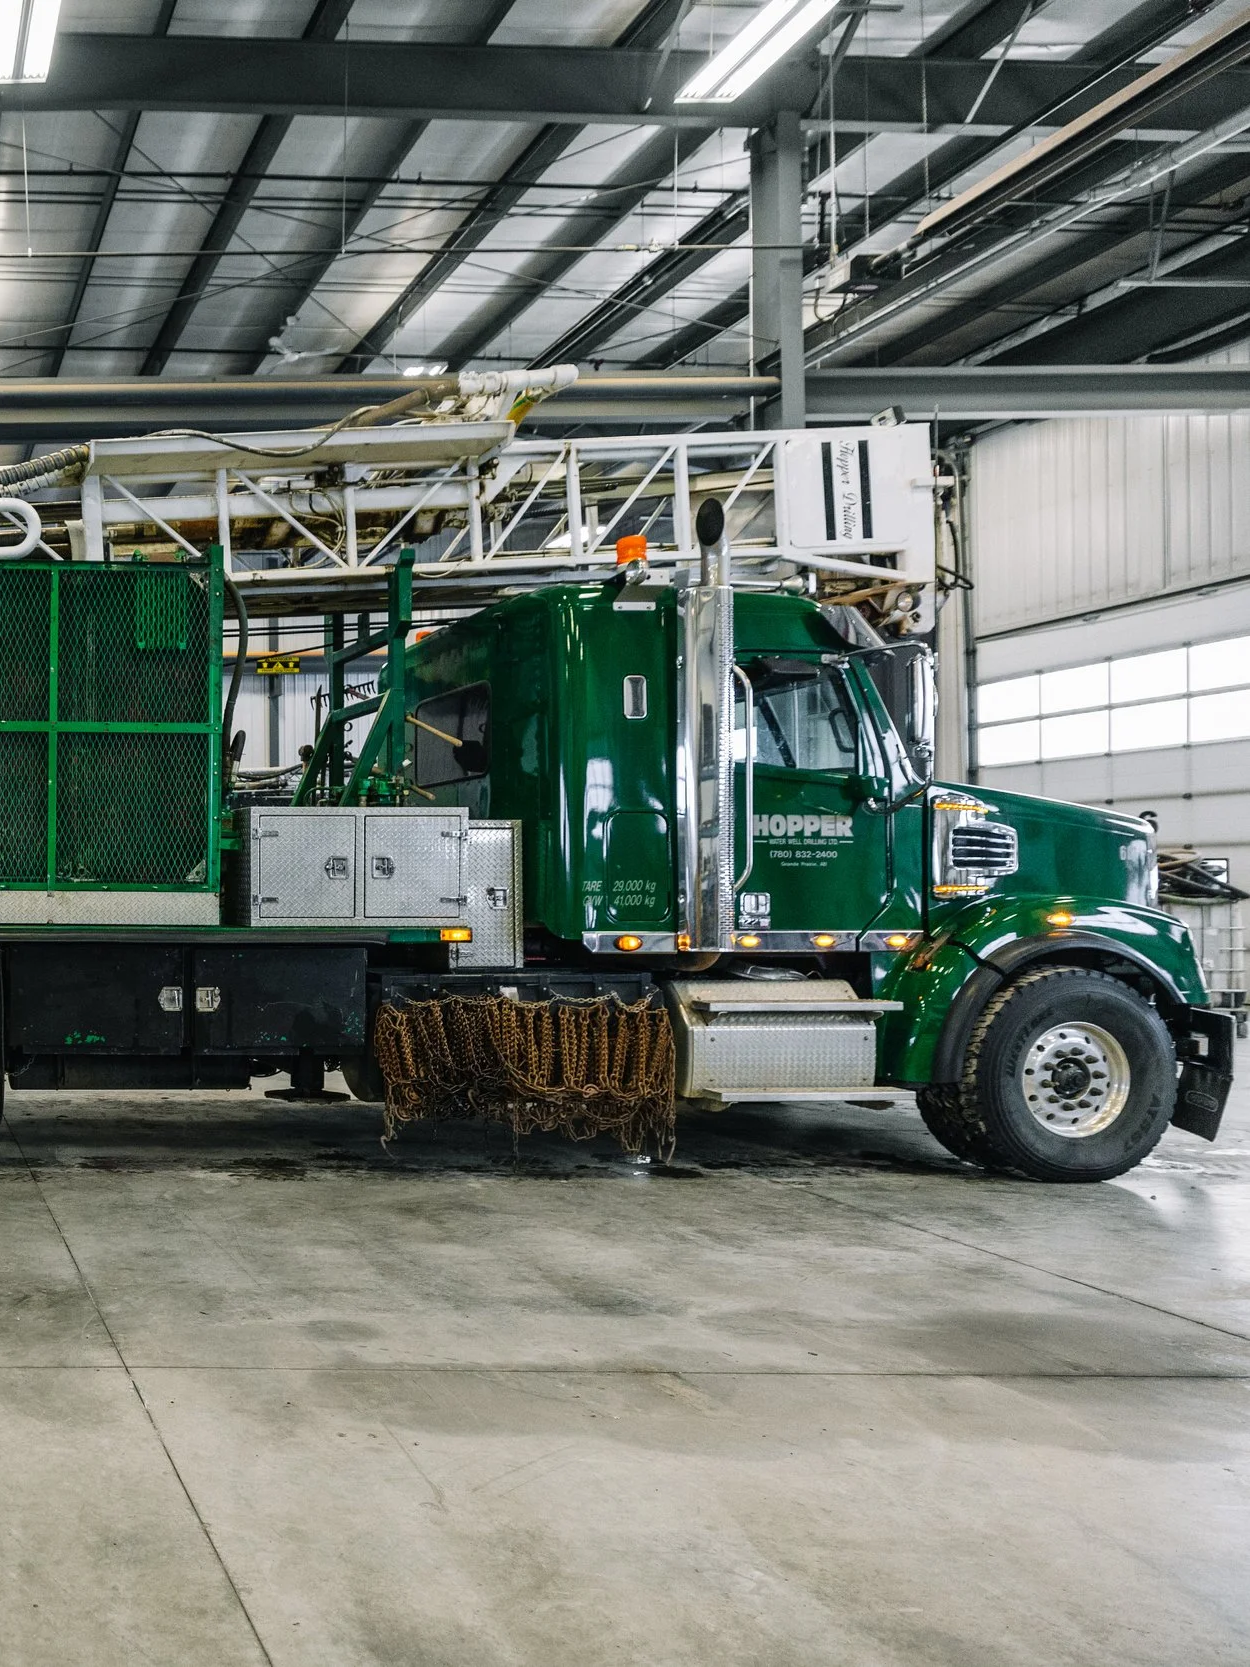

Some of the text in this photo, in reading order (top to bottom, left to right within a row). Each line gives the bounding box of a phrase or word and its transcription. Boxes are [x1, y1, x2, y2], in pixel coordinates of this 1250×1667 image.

[836, 440, 857, 539] Hopper Drilling
[752, 814, 854, 837] HOPPER
[770, 850, 838, 859] (780) 832-2400
[581, 880, 603, 892] TARE
[645, 880, 657, 893] kg
[644, 895, 656, 908] kg
